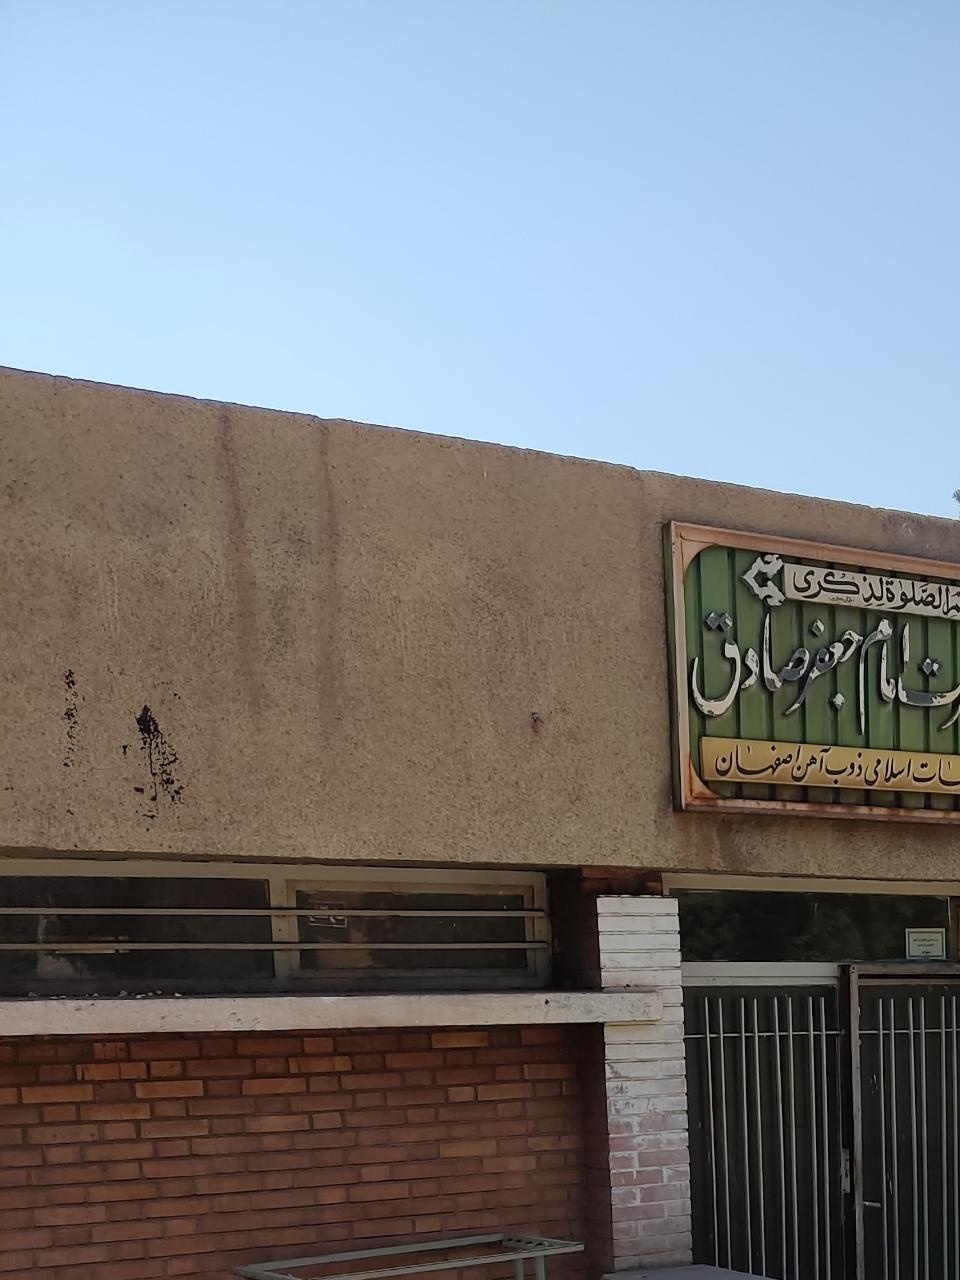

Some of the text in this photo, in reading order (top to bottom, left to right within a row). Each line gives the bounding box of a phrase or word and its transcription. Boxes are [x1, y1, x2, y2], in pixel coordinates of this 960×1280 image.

[691, 611, 810, 717] صادق
[783, 618, 864, 715] جعفر
[859, 618, 911, 735] امام
[715, 744, 801, 777] اصفهان
[791, 746, 831, 782] آهن
[825, 752, 863, 785] ذوب
[864, 757, 912, 786] اسلامی
